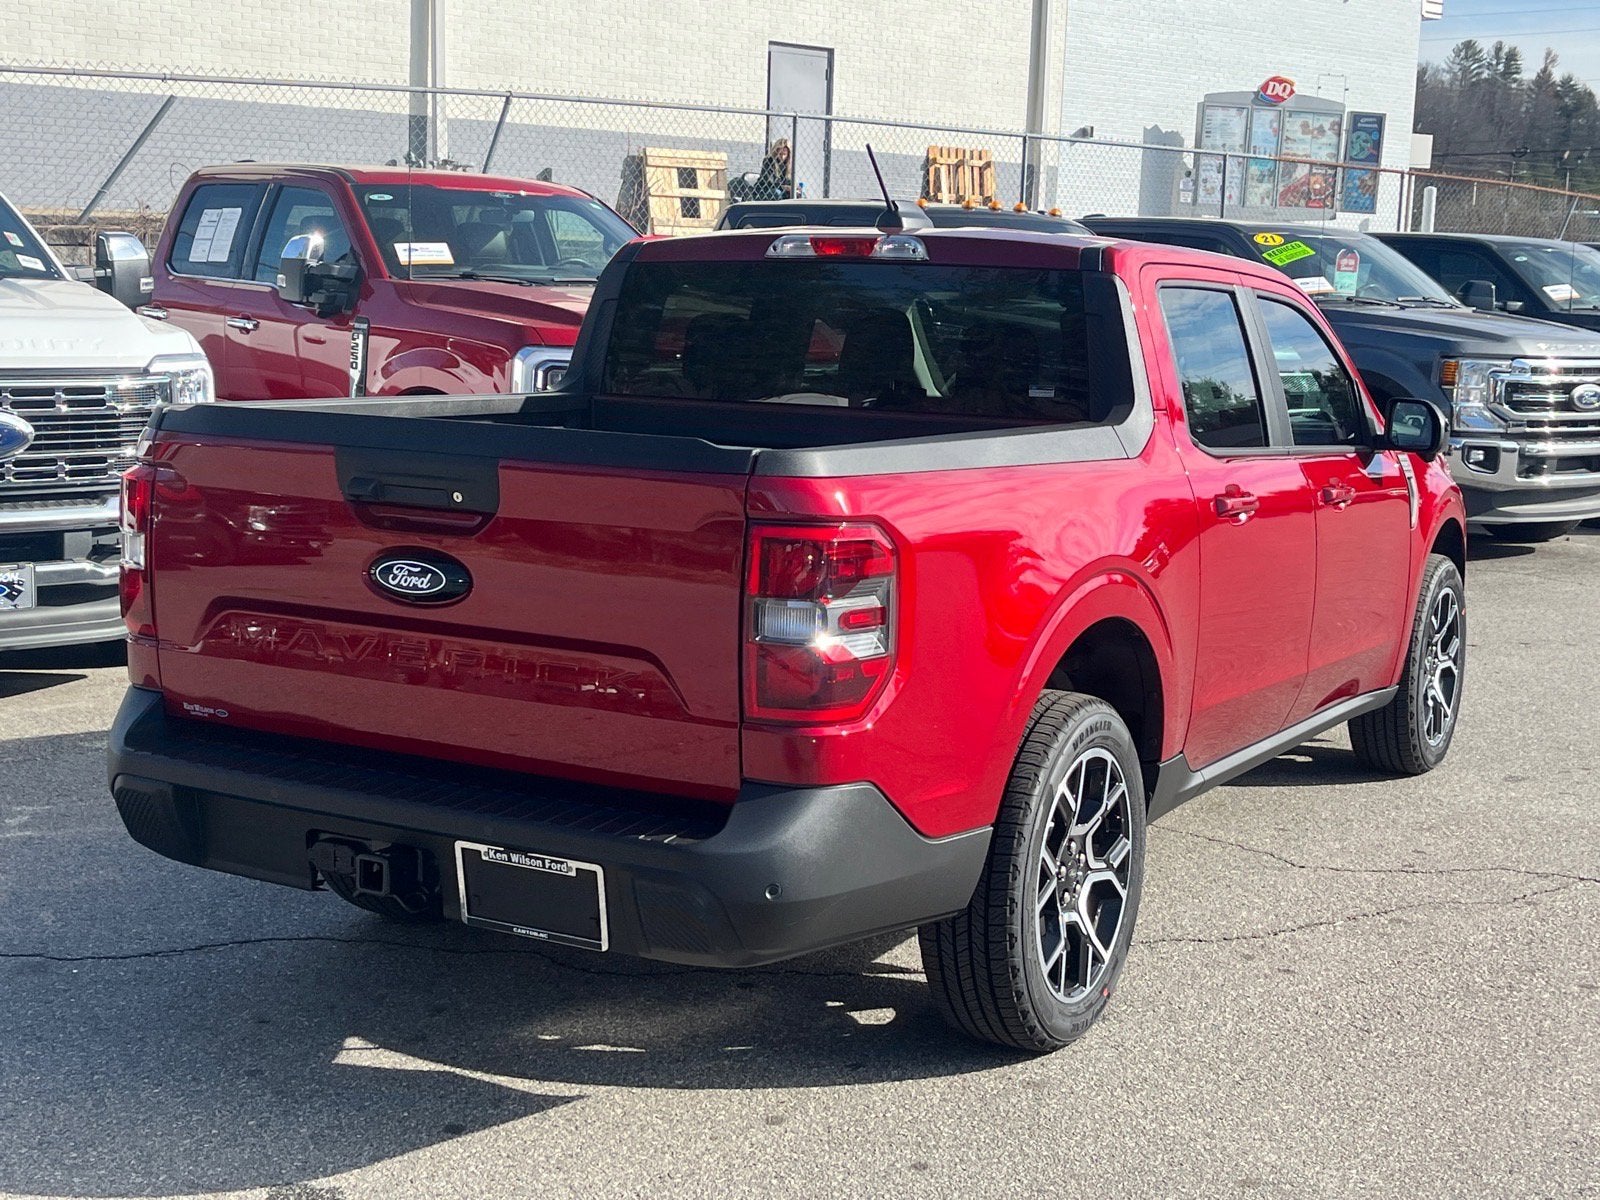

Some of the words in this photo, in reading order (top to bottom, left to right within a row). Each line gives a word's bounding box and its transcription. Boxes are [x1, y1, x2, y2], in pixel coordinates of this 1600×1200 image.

[1266, 81, 1292, 98] DQ
[1267, 243, 1301, 258] REDUCED
[388, 564, 432, 588] Ford
[230, 620, 647, 698] MAVERICK
[489, 849, 507, 860] Ken
[510, 853, 542, 867] Wilson
[545, 860, 567, 872] Ford
